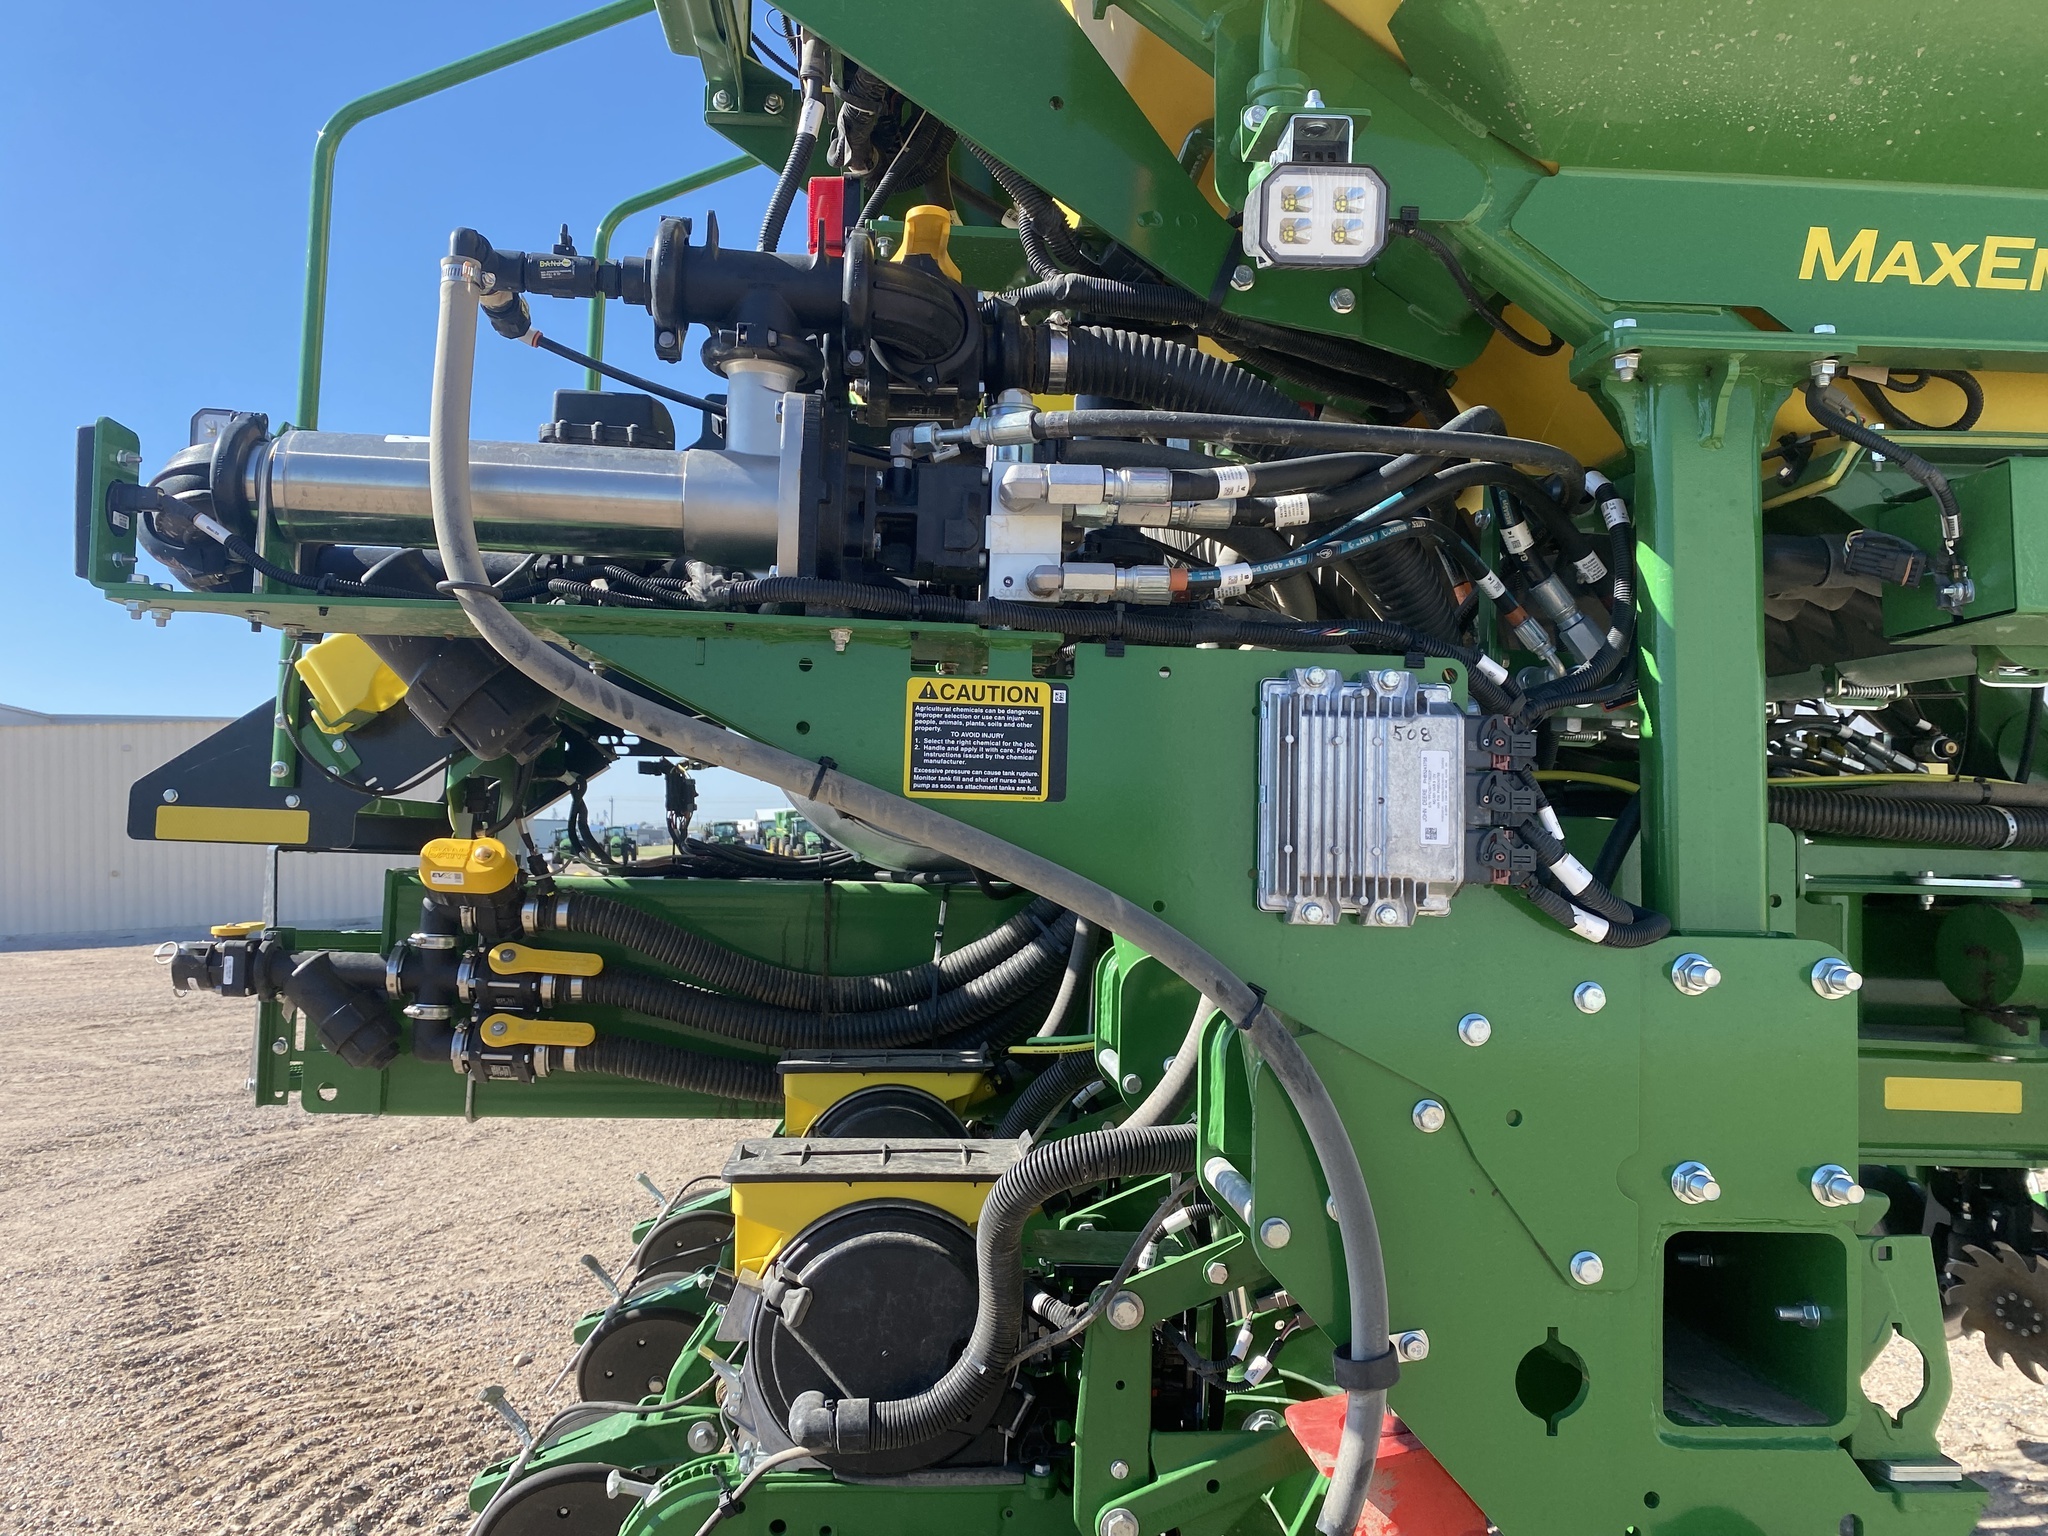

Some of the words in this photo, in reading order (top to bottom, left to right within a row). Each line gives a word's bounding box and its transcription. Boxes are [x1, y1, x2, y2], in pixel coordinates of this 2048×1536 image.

[1263, 561, 1283, 571] 4800
[940, 683, 1039, 703] CAUTION
[1007, 708, 1040, 716] dangerous.
[1393, 725, 1433, 742] 508
